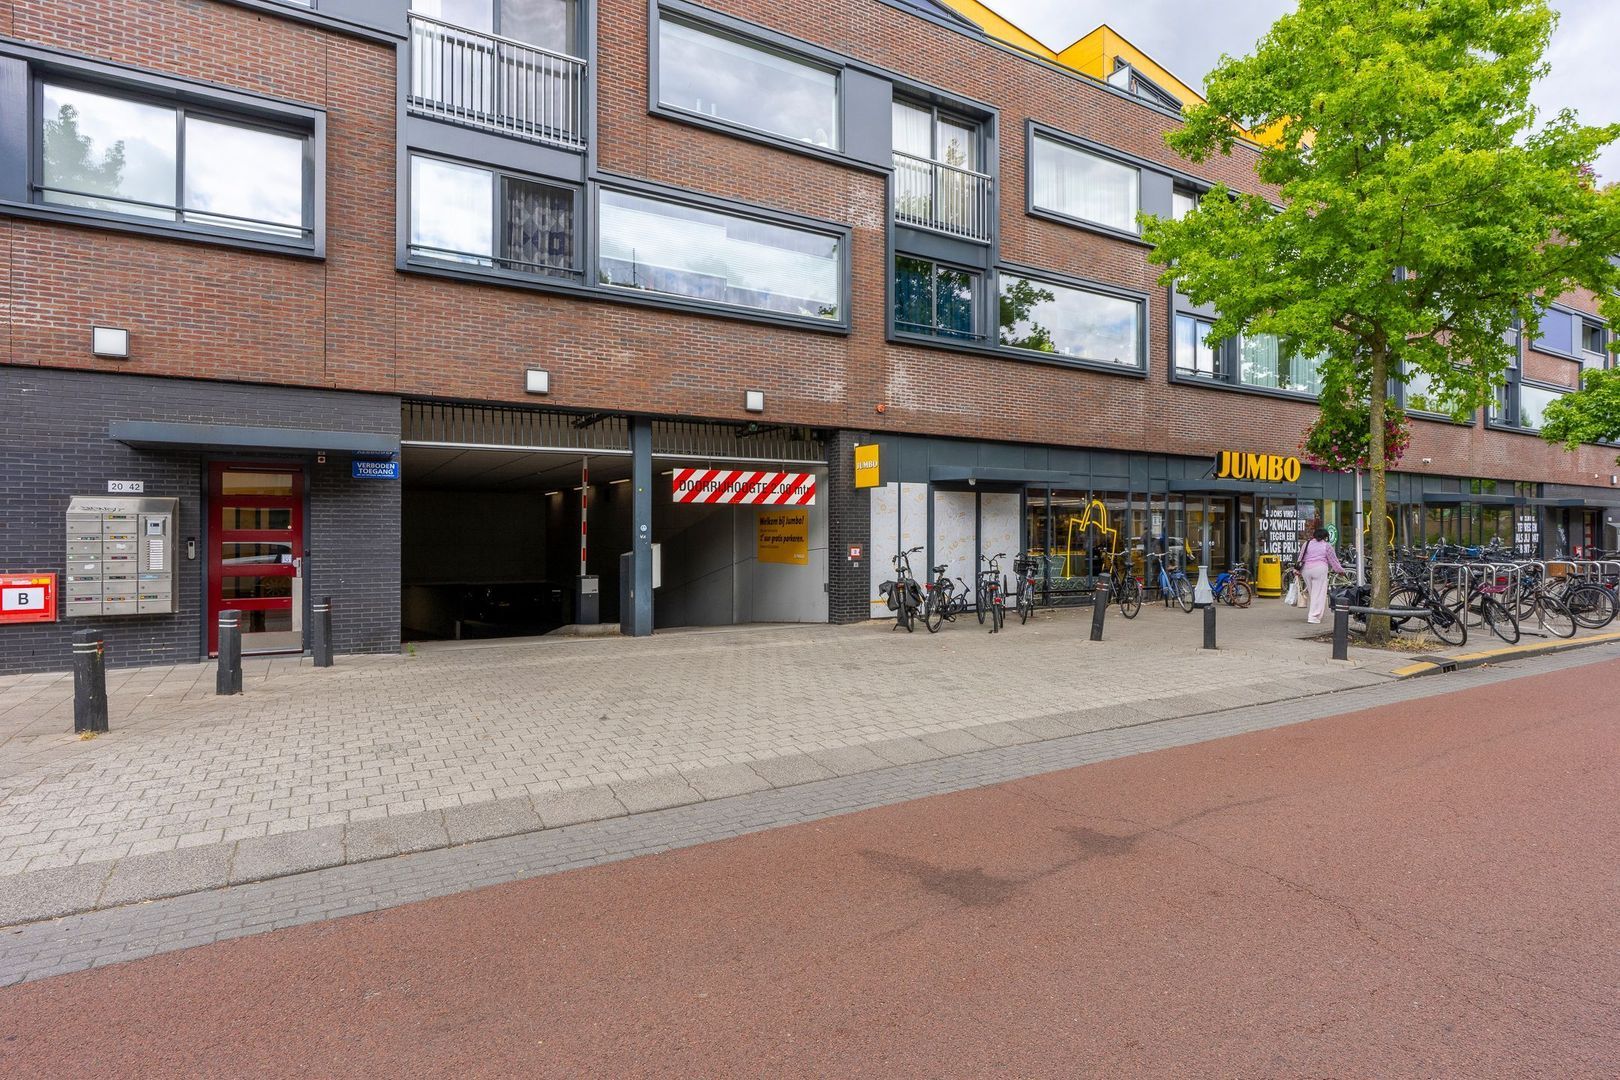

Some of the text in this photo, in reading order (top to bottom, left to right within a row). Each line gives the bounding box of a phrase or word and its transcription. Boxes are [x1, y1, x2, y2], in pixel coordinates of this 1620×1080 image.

[856, 460, 878, 470] JUMBO
[1217, 450, 1301, 482] JUMBO
[111, 483, 140, 491] 20 42
[679, 479, 811, 495] DOORRIJHOOGTE 2.00 mtr
[1265, 509, 1273, 518] BJ
[1286, 532, 1296, 541] EEN
[1283, 554, 1293, 562] DAG
[18, 592, 29, 605] B
